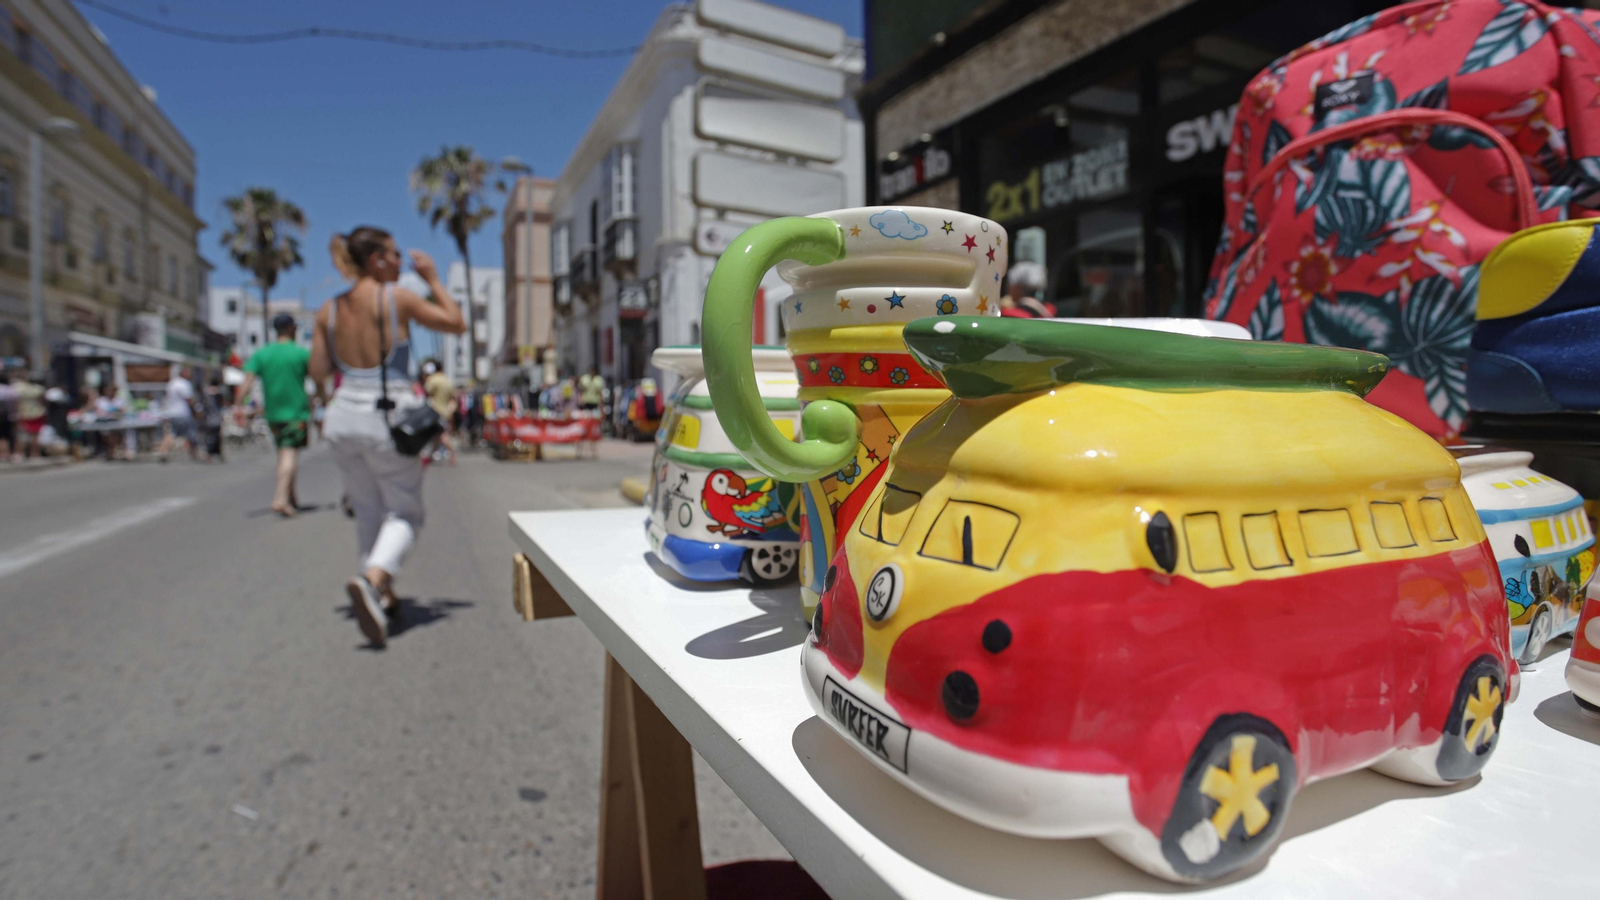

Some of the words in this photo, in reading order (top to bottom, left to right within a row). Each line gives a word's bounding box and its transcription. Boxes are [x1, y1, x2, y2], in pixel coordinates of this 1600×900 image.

[986, 167, 1041, 222] 2x1
[1042, 162, 1129, 208] OUTLET
[831, 689, 890, 759] SURFER
